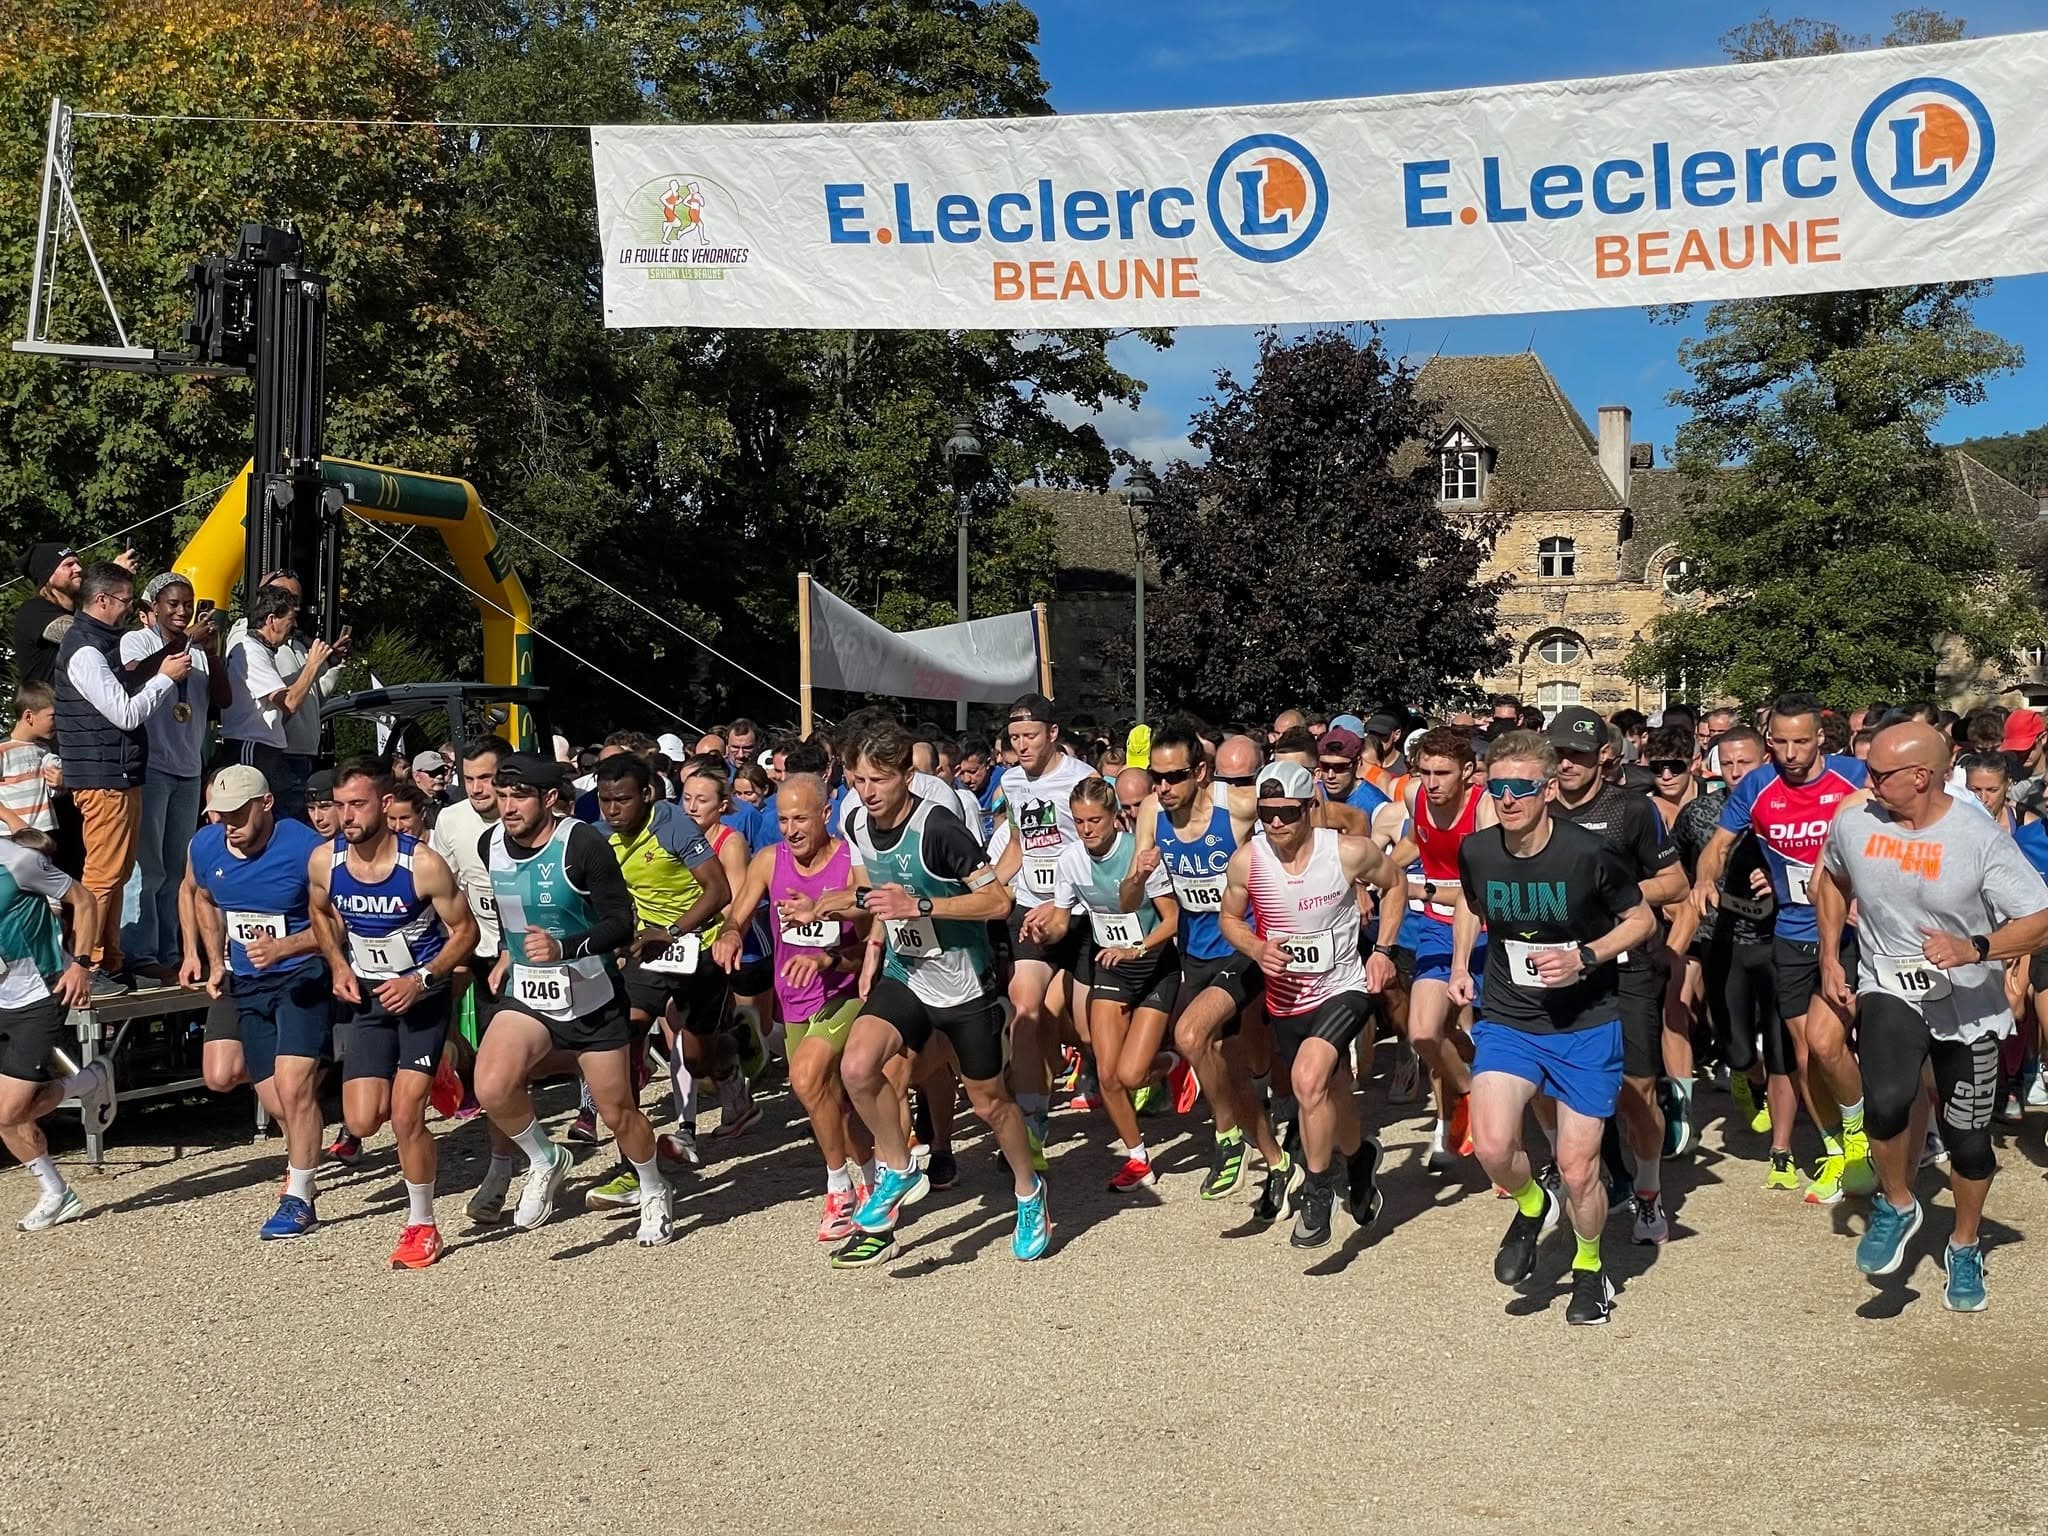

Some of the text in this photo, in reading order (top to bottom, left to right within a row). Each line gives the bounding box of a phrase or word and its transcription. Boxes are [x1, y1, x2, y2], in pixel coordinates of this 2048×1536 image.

[1404, 142, 1837, 227] E.Leclerc
[825, 179, 1195, 244] E.Leclerc
[619, 247, 749, 263] LA FOULÉE DES VENDANGES
[1595, 217, 1840, 278] BEAUNE
[694, 269, 722, 280] BEAUNE
[993, 257, 1199, 300] BEAUNE
[1863, 833, 1943, 859] ATHLETIC
[1034, 869, 1054, 885] 177
[352, 895, 407, 913] DMA
[1183, 888, 1222, 904] 1183
[1487, 880, 1568, 921] RUN
[894, 927, 922, 947] 166
[1105, 925, 1128, 941] 311
[368, 948, 389, 964] 71
[521, 980, 560, 1000] 1246
[1895, 971, 1930, 991] 119
[1971, 1039, 1999, 1129] THLETIC
